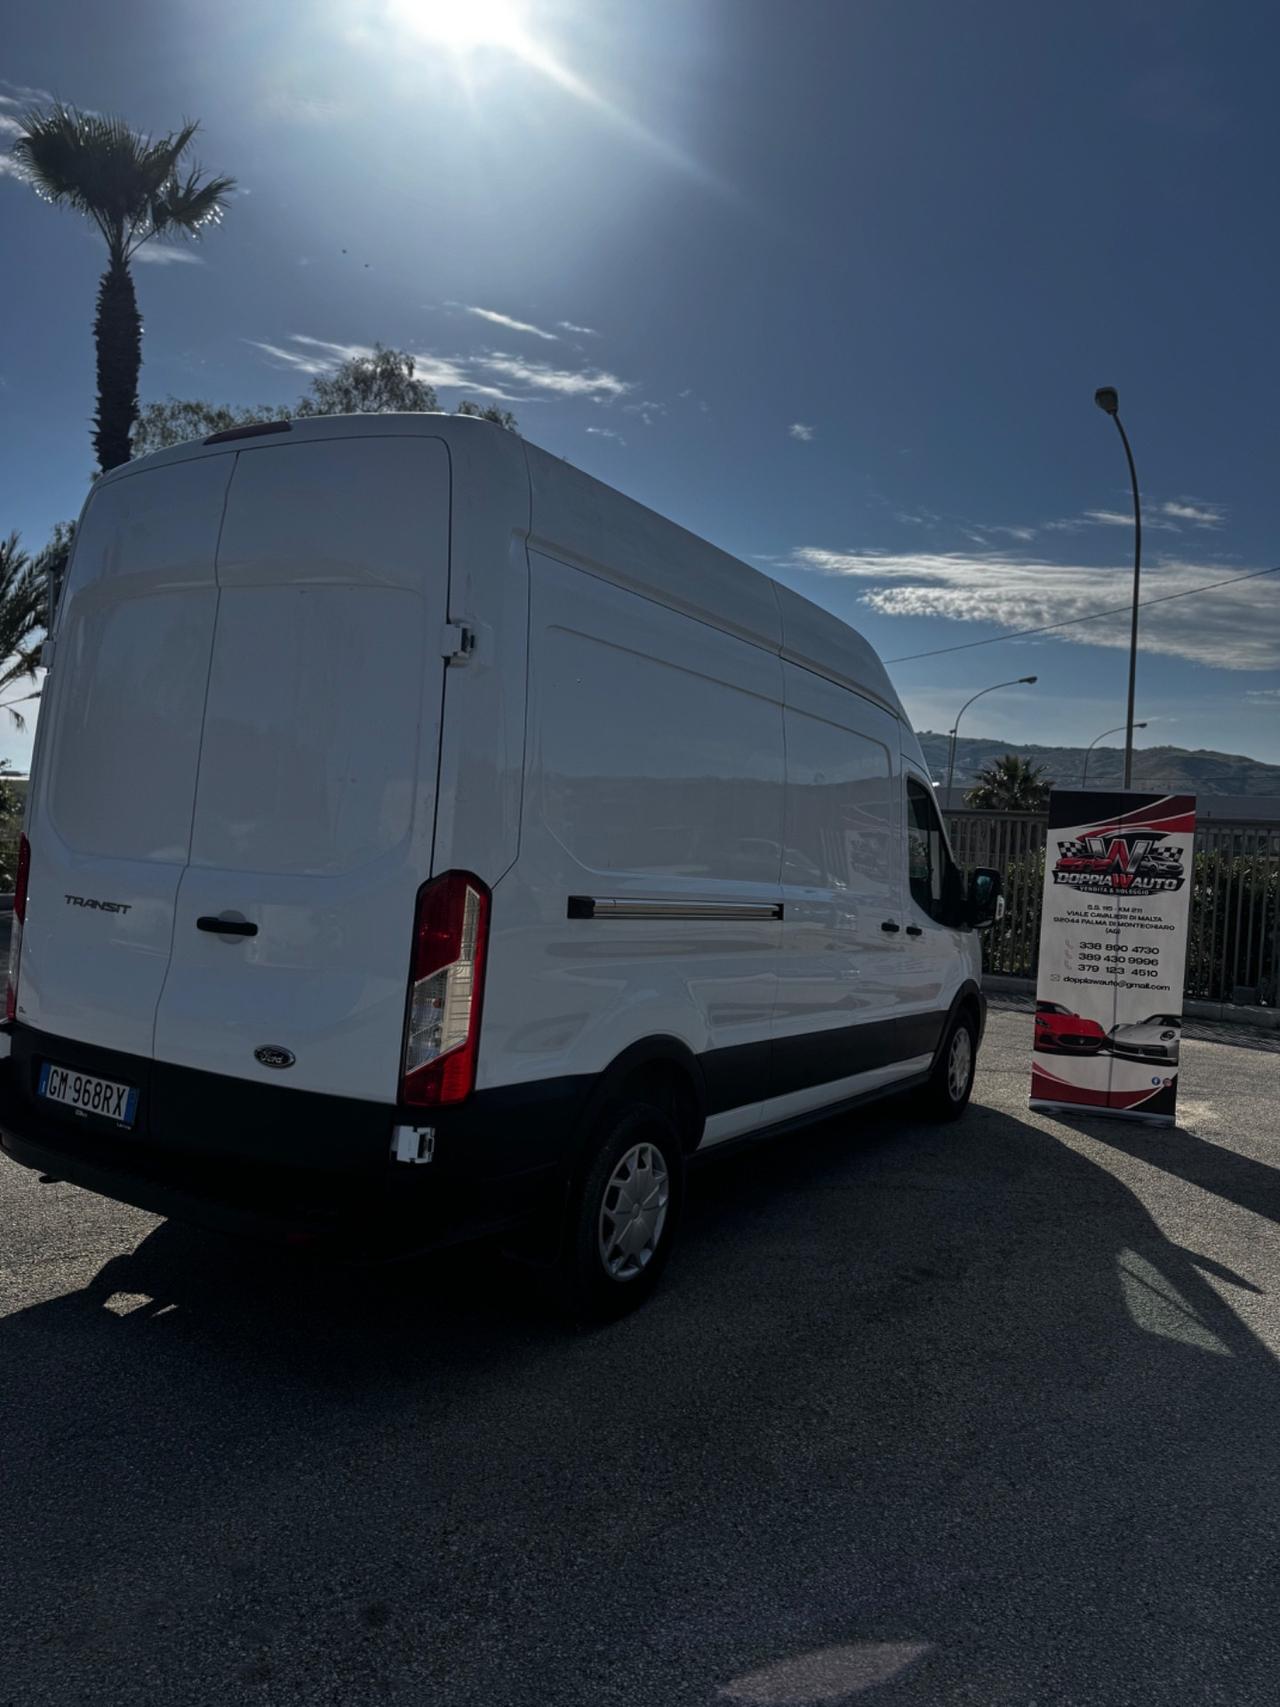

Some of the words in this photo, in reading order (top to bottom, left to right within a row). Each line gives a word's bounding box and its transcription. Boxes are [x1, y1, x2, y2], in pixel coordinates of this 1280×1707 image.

[64, 894, 131, 914] TRANSIT
[1053, 916, 1080, 924] 92044
[1081, 918, 1107, 926] PALMA
[1117, 921, 1175, 931] MONTECHIARO
[1066, 910, 1089, 918] VIALE
[1137, 915, 1163, 923] MALTA
[1079, 941, 1102, 950] 338
[1104, 943, 1128, 953] 890
[1131, 945, 1160, 955] 4730
[1078, 953, 1101, 961] 389
[1103, 954, 1126, 964] 430
[1127, 956, 1159, 966] 9996
[1077, 964, 1100, 973] 379
[1106, 966, 1125, 975] 123
[1131, 968, 1158, 978] 4510
[1063, 975, 1171, 991] doppiawauto@gmail.com
